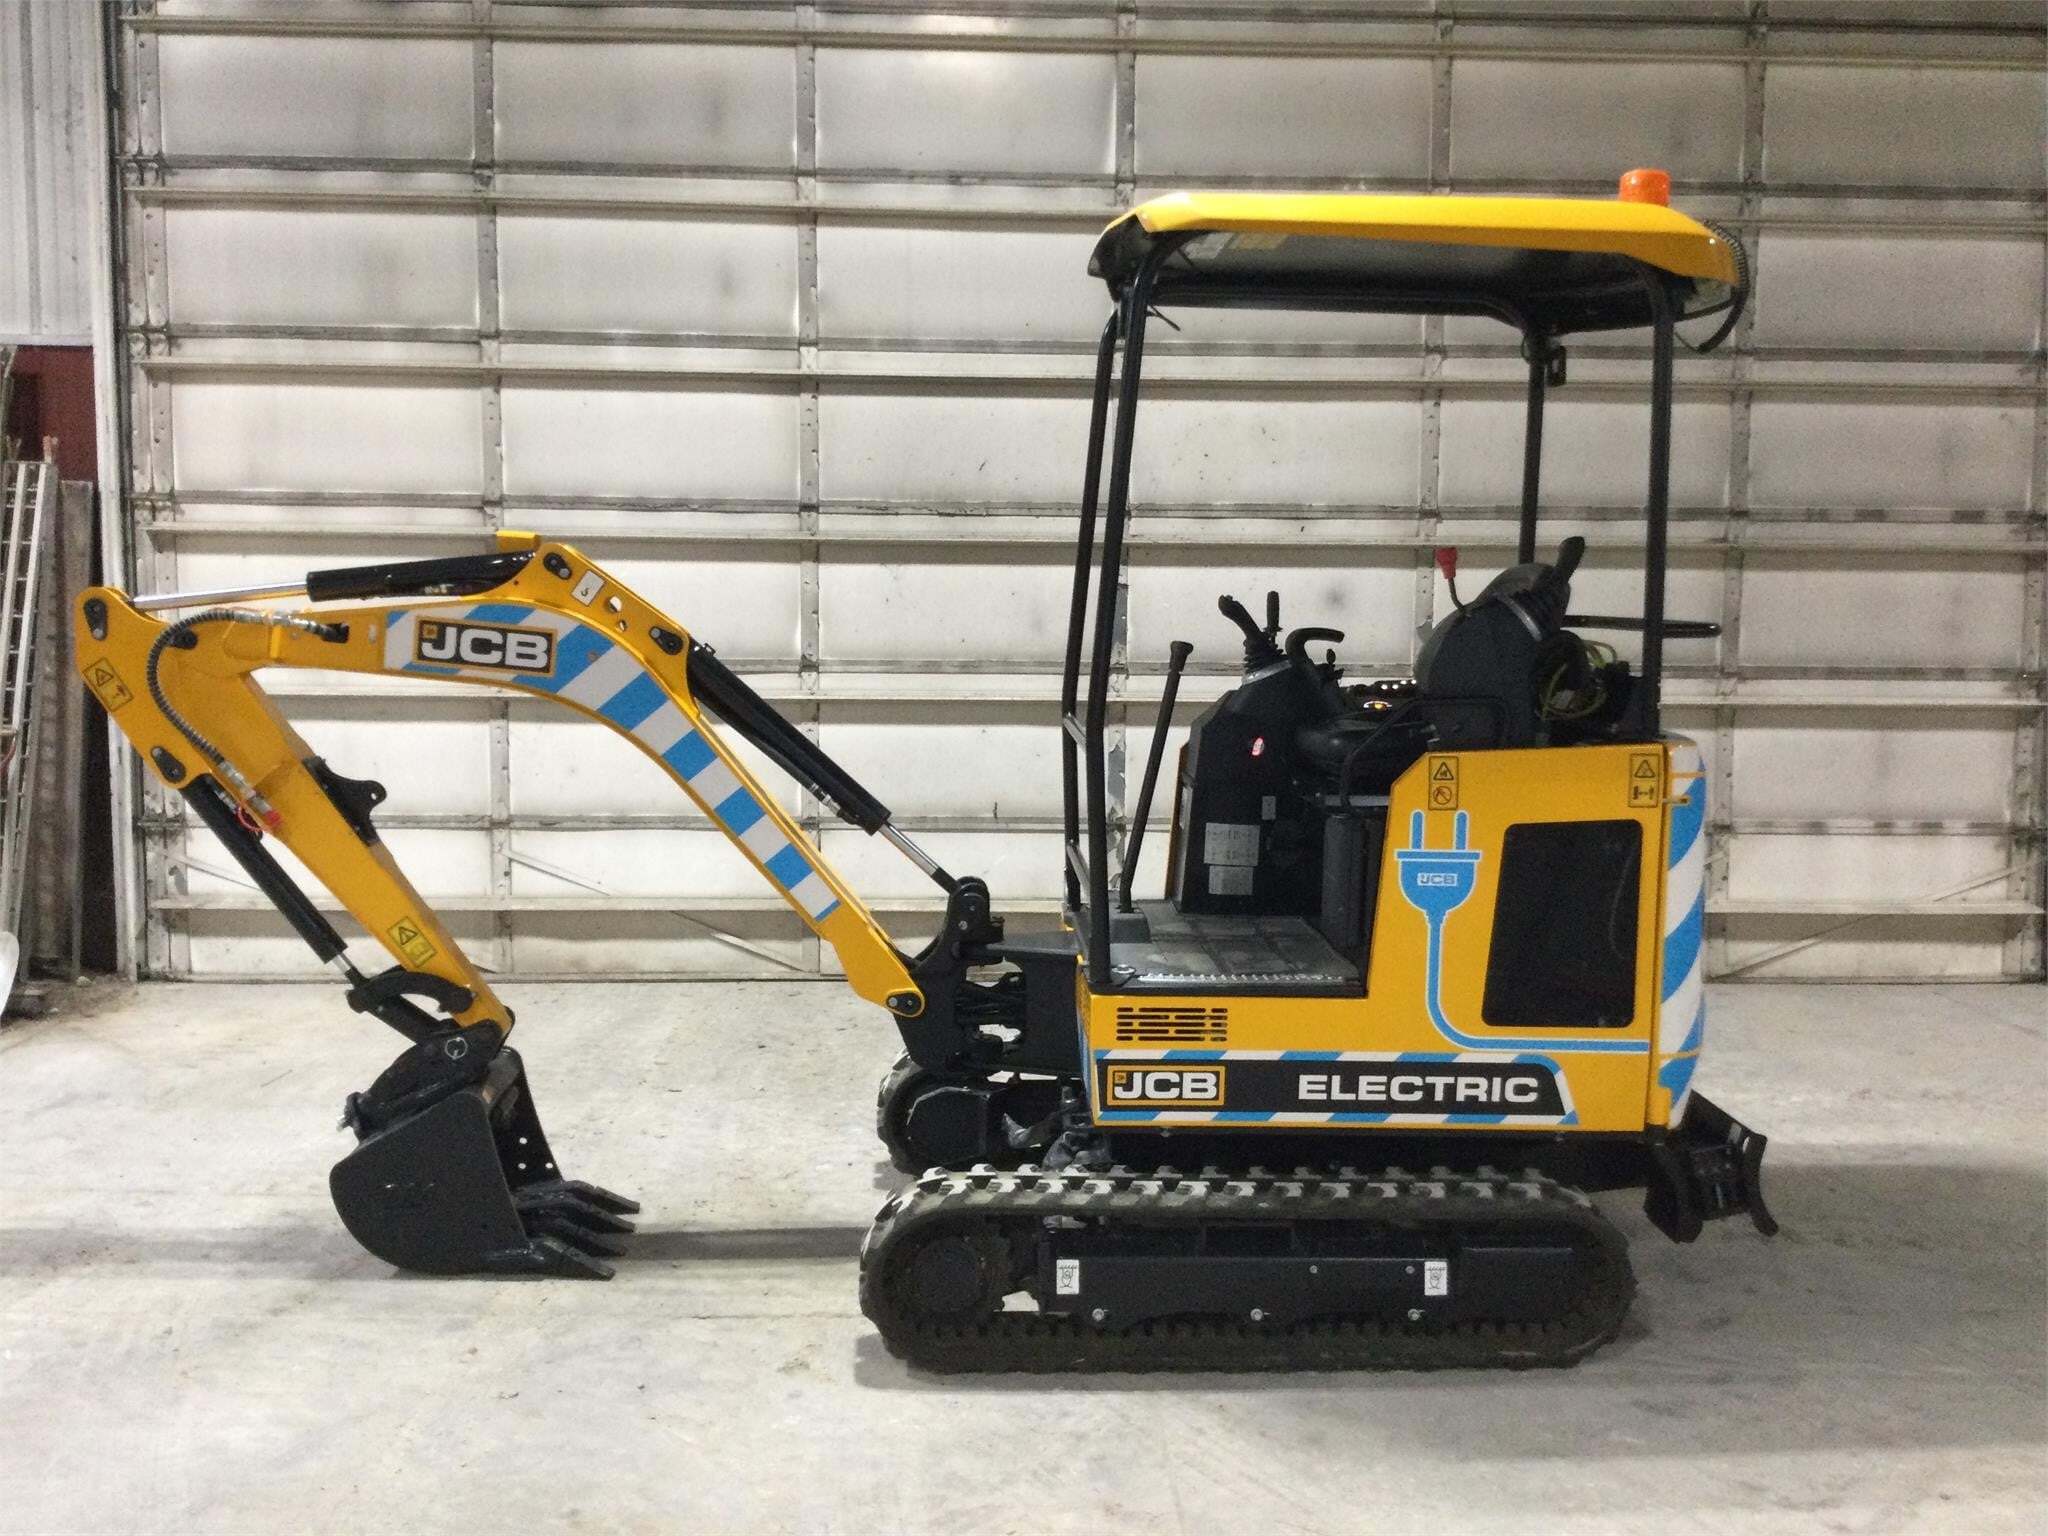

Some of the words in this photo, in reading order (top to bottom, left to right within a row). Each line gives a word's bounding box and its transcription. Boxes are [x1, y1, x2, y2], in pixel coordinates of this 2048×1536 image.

[421, 626, 548, 669] JCB
[1420, 874, 1456, 885] JCB
[1114, 1072, 1217, 1099] JCB
[1298, 1074, 1539, 1103] ELECTRIC
